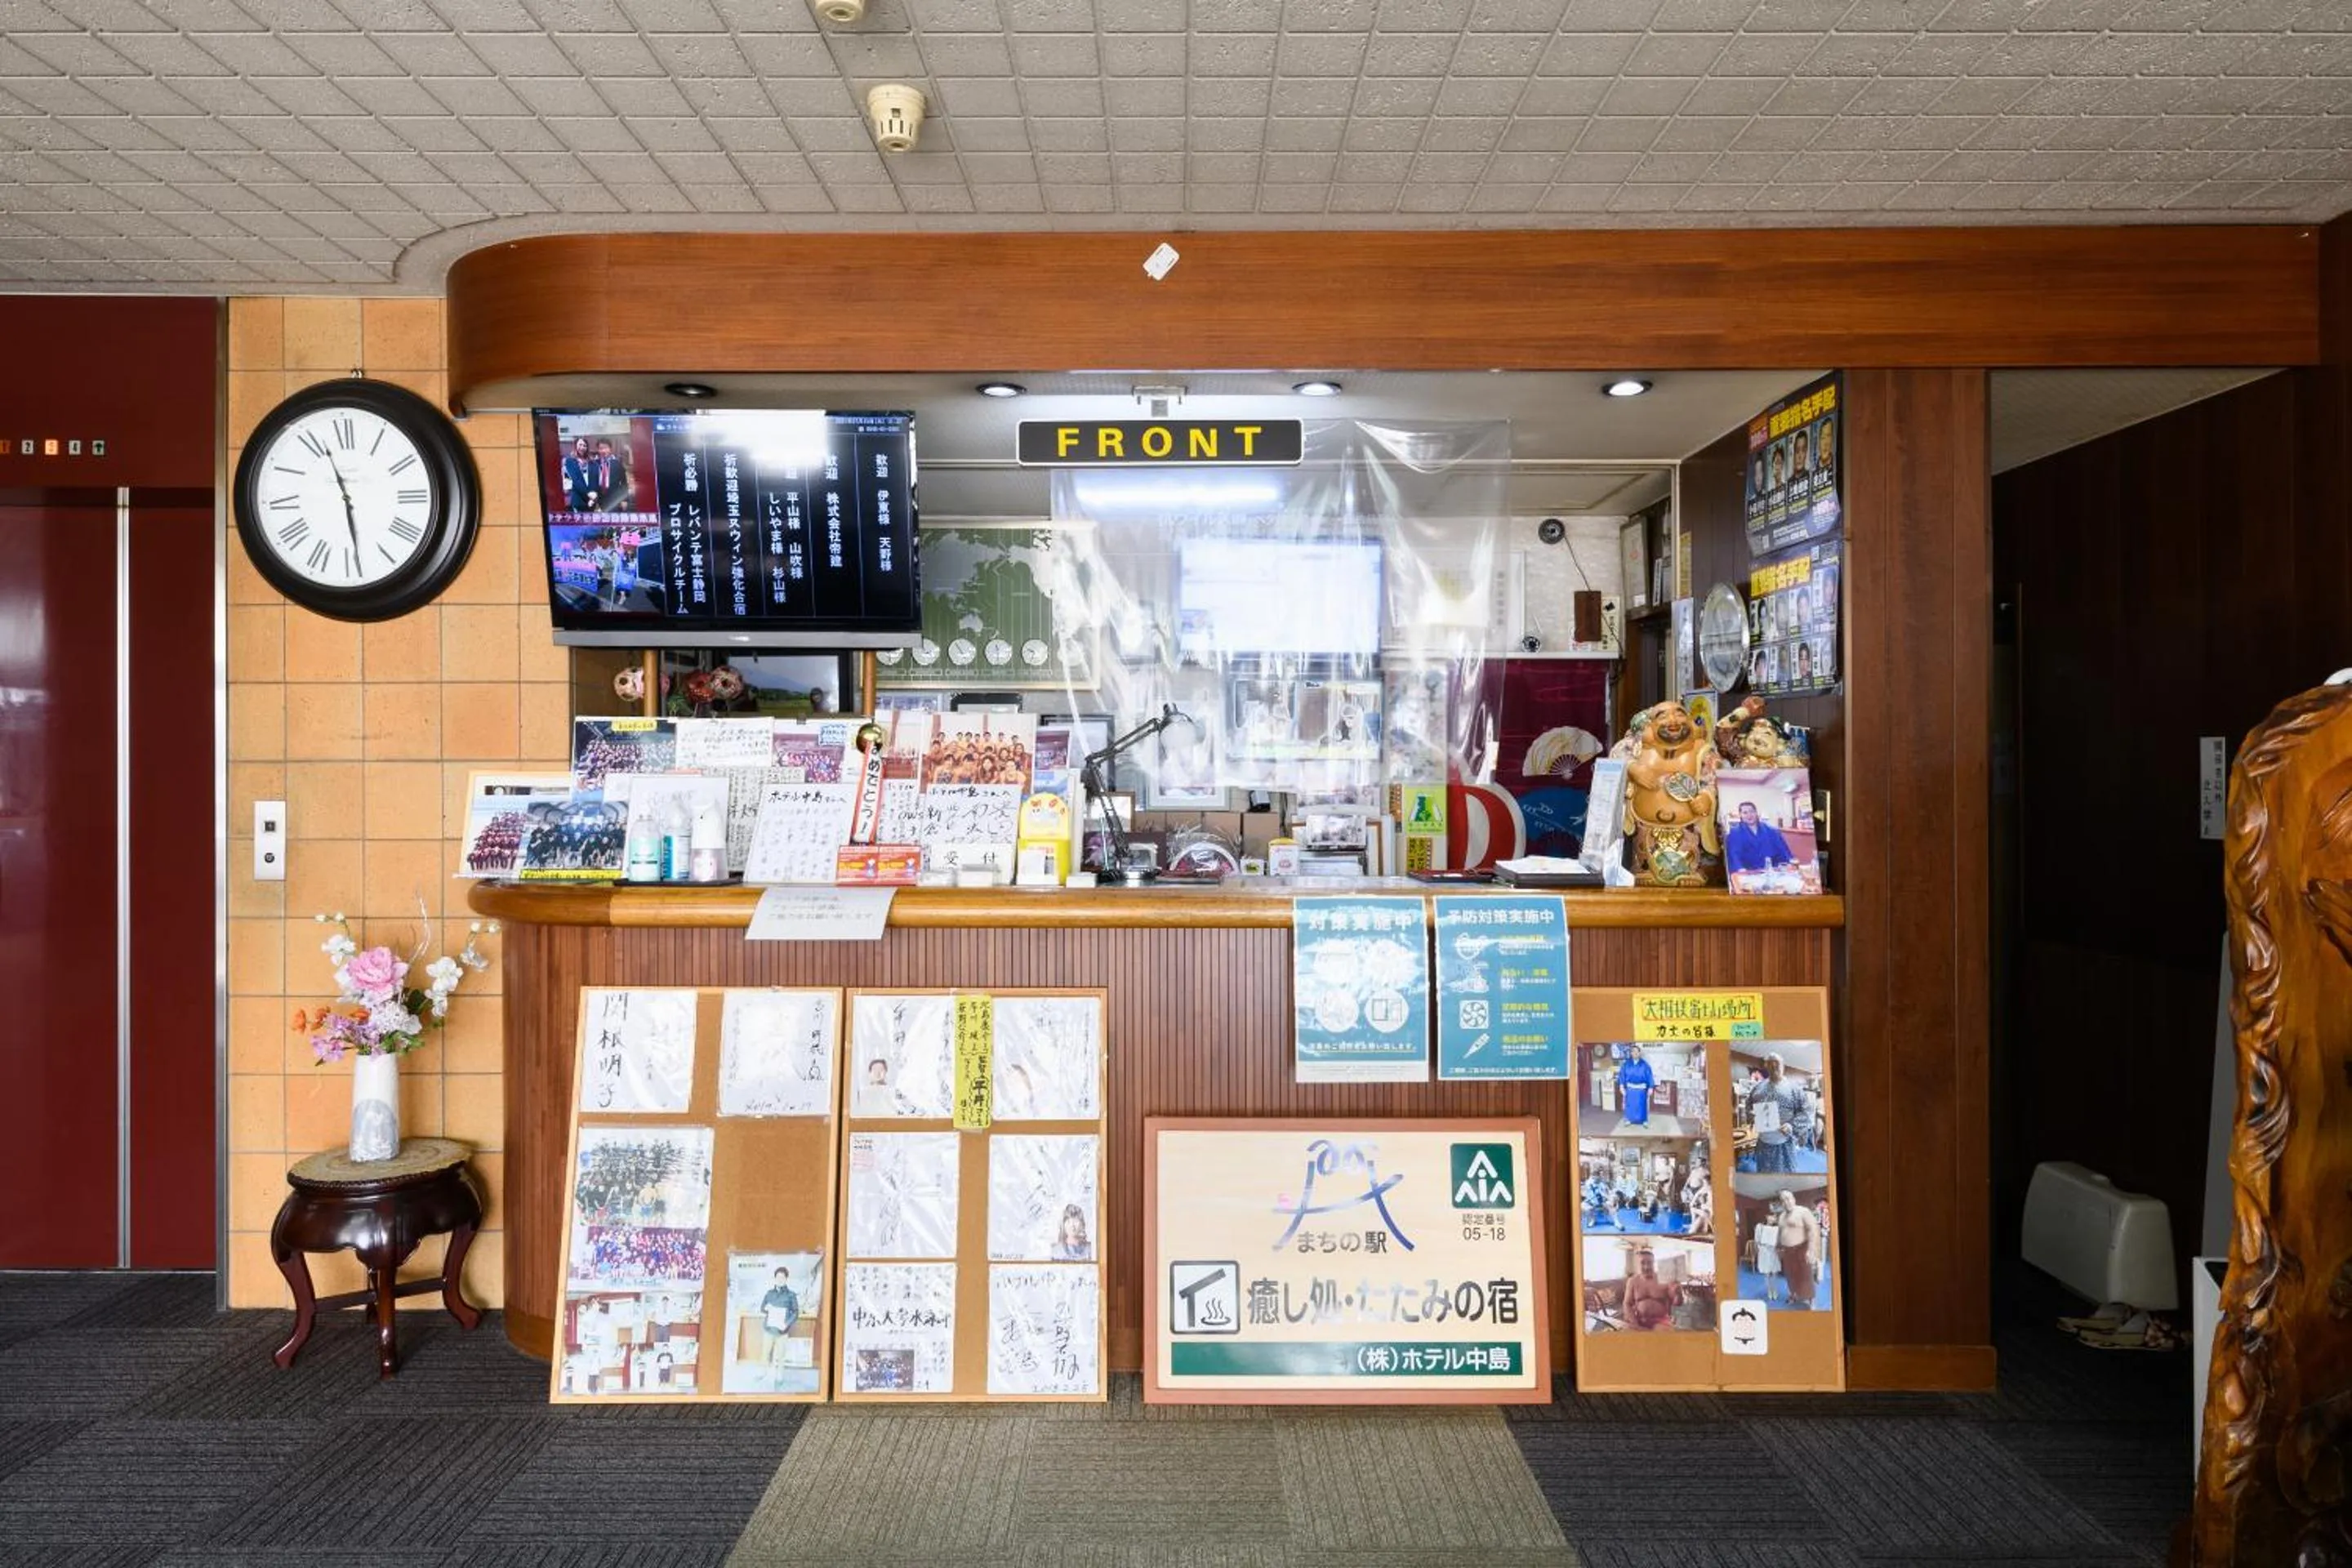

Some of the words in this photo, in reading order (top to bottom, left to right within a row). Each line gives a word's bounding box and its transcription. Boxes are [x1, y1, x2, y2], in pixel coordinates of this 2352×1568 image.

[1057, 426, 1262, 458] FRONT
[1297, 1230, 1388, 1254] まちの駅
[1463, 1227, 1506, 1241] 05-18
[1246, 1276, 1519, 1325] 癒し処・たたみの宿
[1356, 1346, 1512, 1373] (株)ホテル中島
